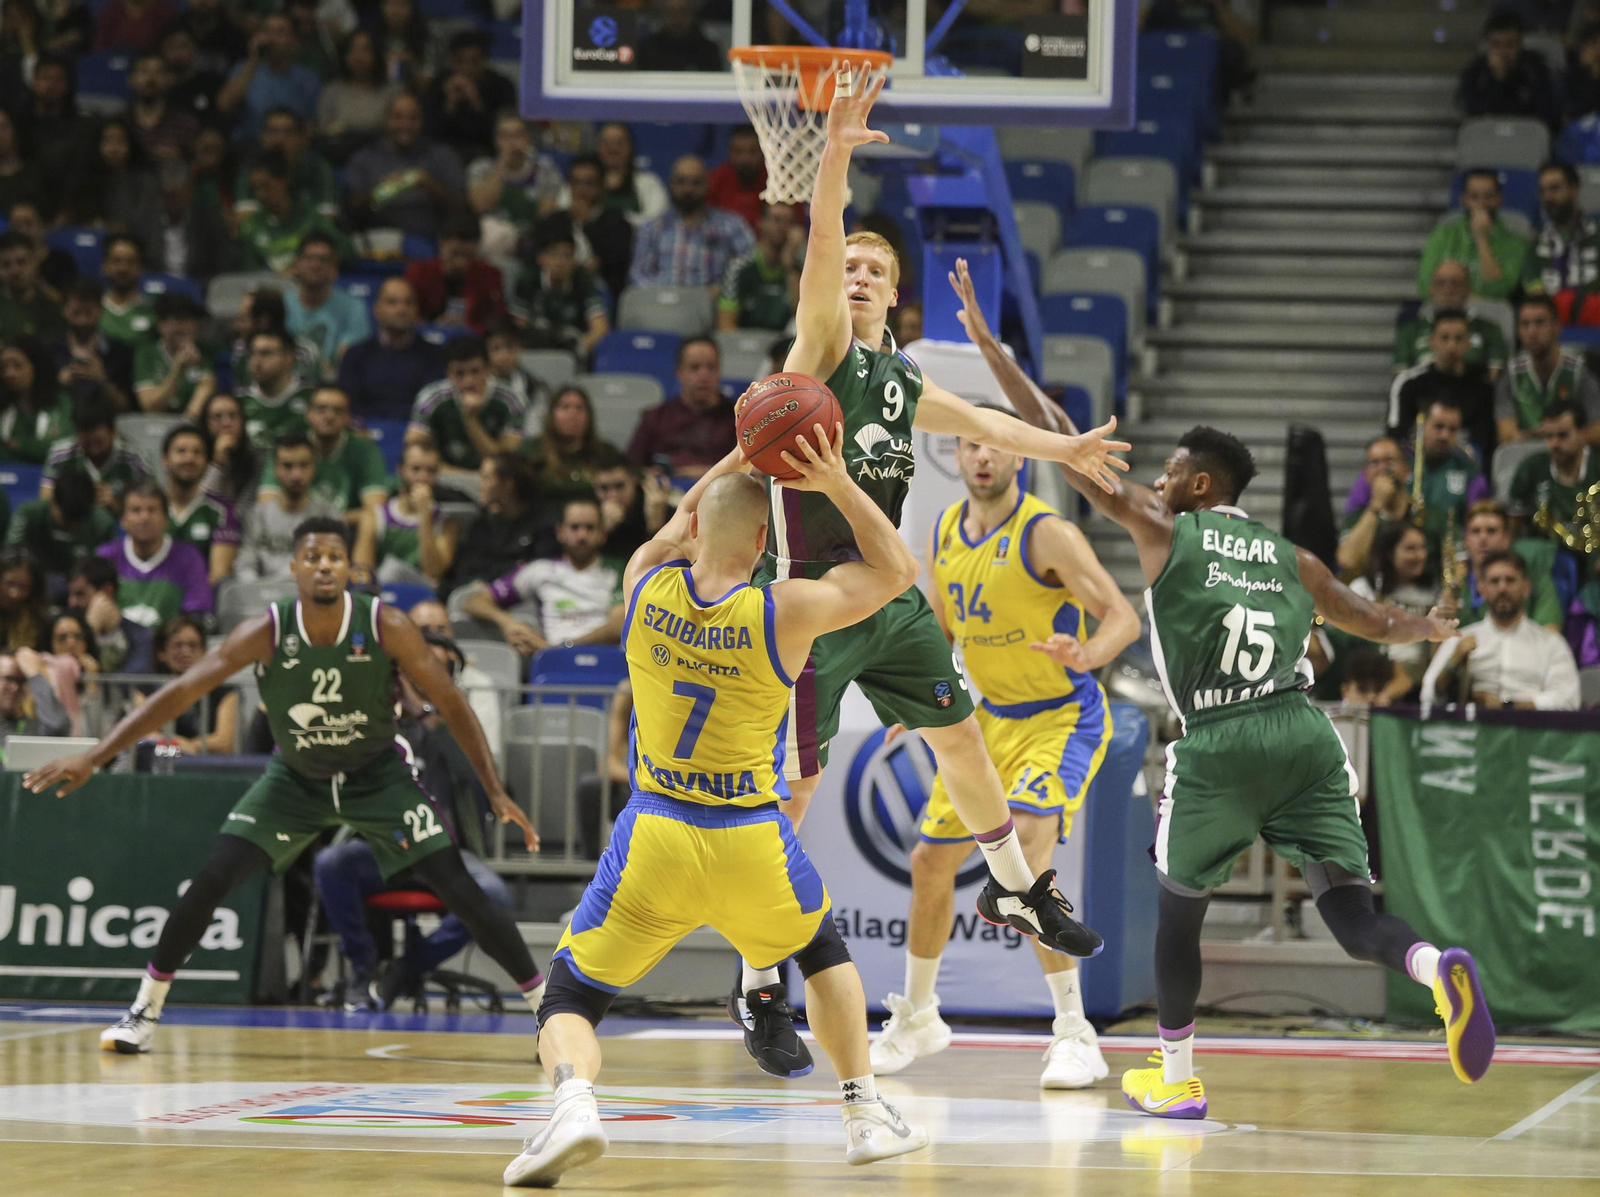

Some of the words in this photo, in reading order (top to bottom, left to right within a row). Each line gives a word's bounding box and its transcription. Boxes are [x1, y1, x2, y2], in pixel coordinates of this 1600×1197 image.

[882, 380, 904, 422] 9
[890, 438, 914, 456] Uni
[1203, 529, 1278, 564] ELEGAR
[948, 583, 992, 624] 34
[643, 603, 752, 650] SZUBARGA
[1220, 602, 1275, 681] 15
[312, 668, 342, 703] 22
[677, 657, 740, 676] PLICHTA
[673, 680, 716, 759] 7
[403, 803, 443, 843] 22
[0, 876, 244, 965] nicaa
[833, 907, 907, 946] álag
[948, 913, 1023, 949] Wag
